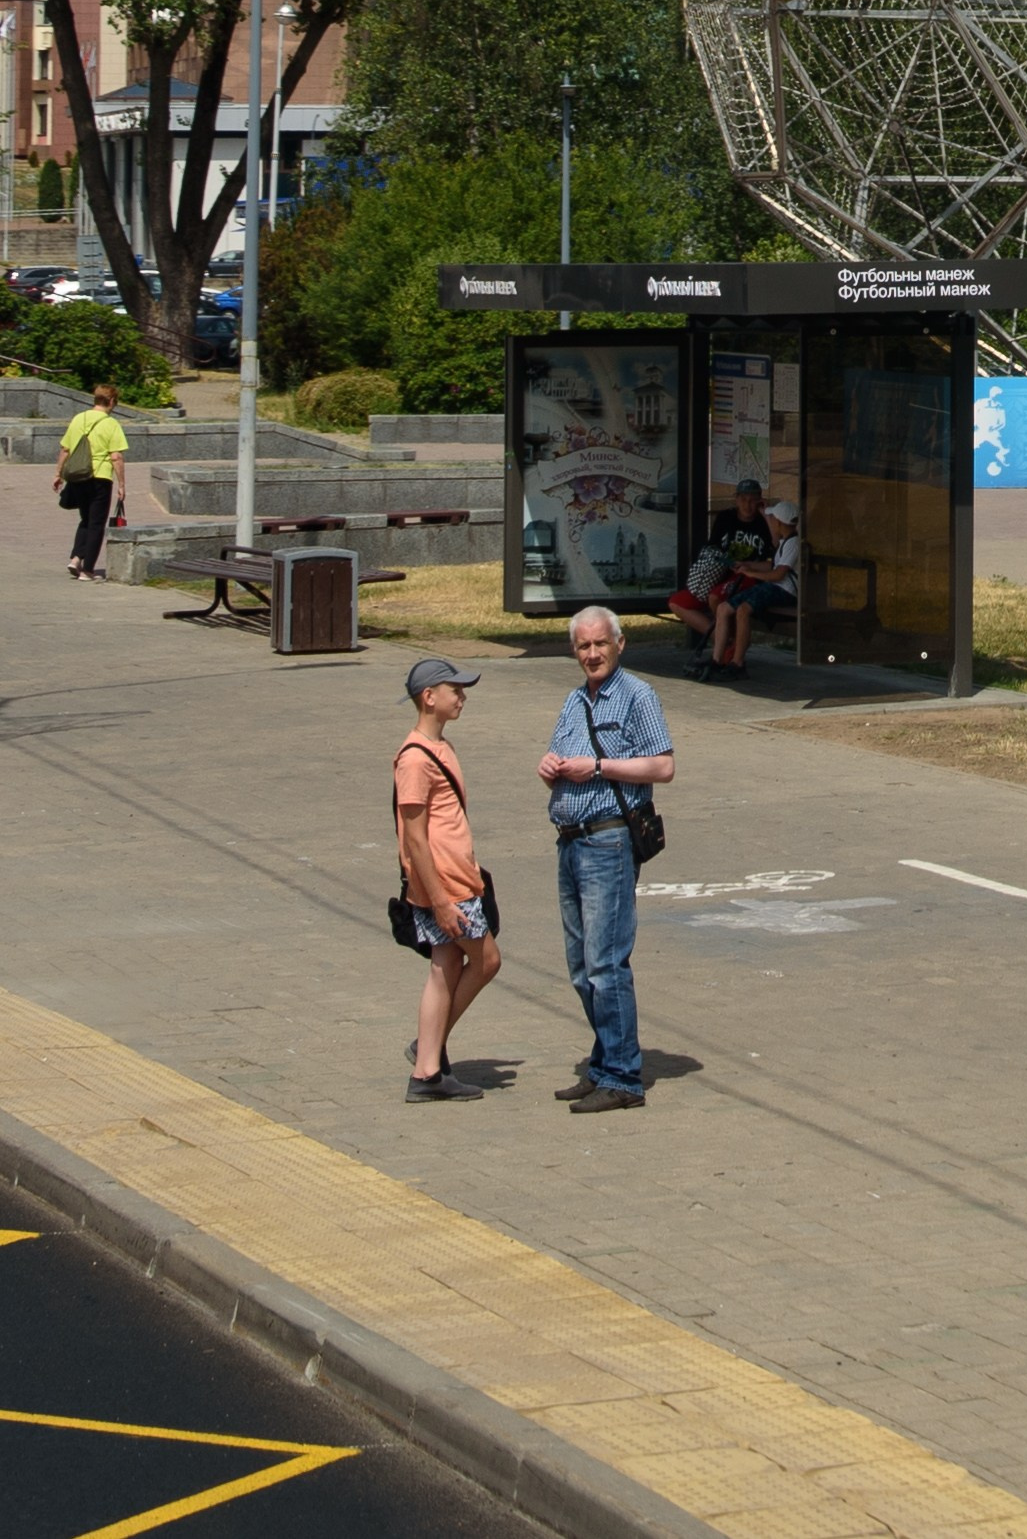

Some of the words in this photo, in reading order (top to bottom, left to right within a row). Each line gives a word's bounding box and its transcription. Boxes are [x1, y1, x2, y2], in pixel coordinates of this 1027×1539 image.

[838, 268, 922, 286] Футбольны
[926, 268, 975, 281] манеж
[838, 282, 936, 303] Футбольный
[940, 284, 991, 297] манеж
